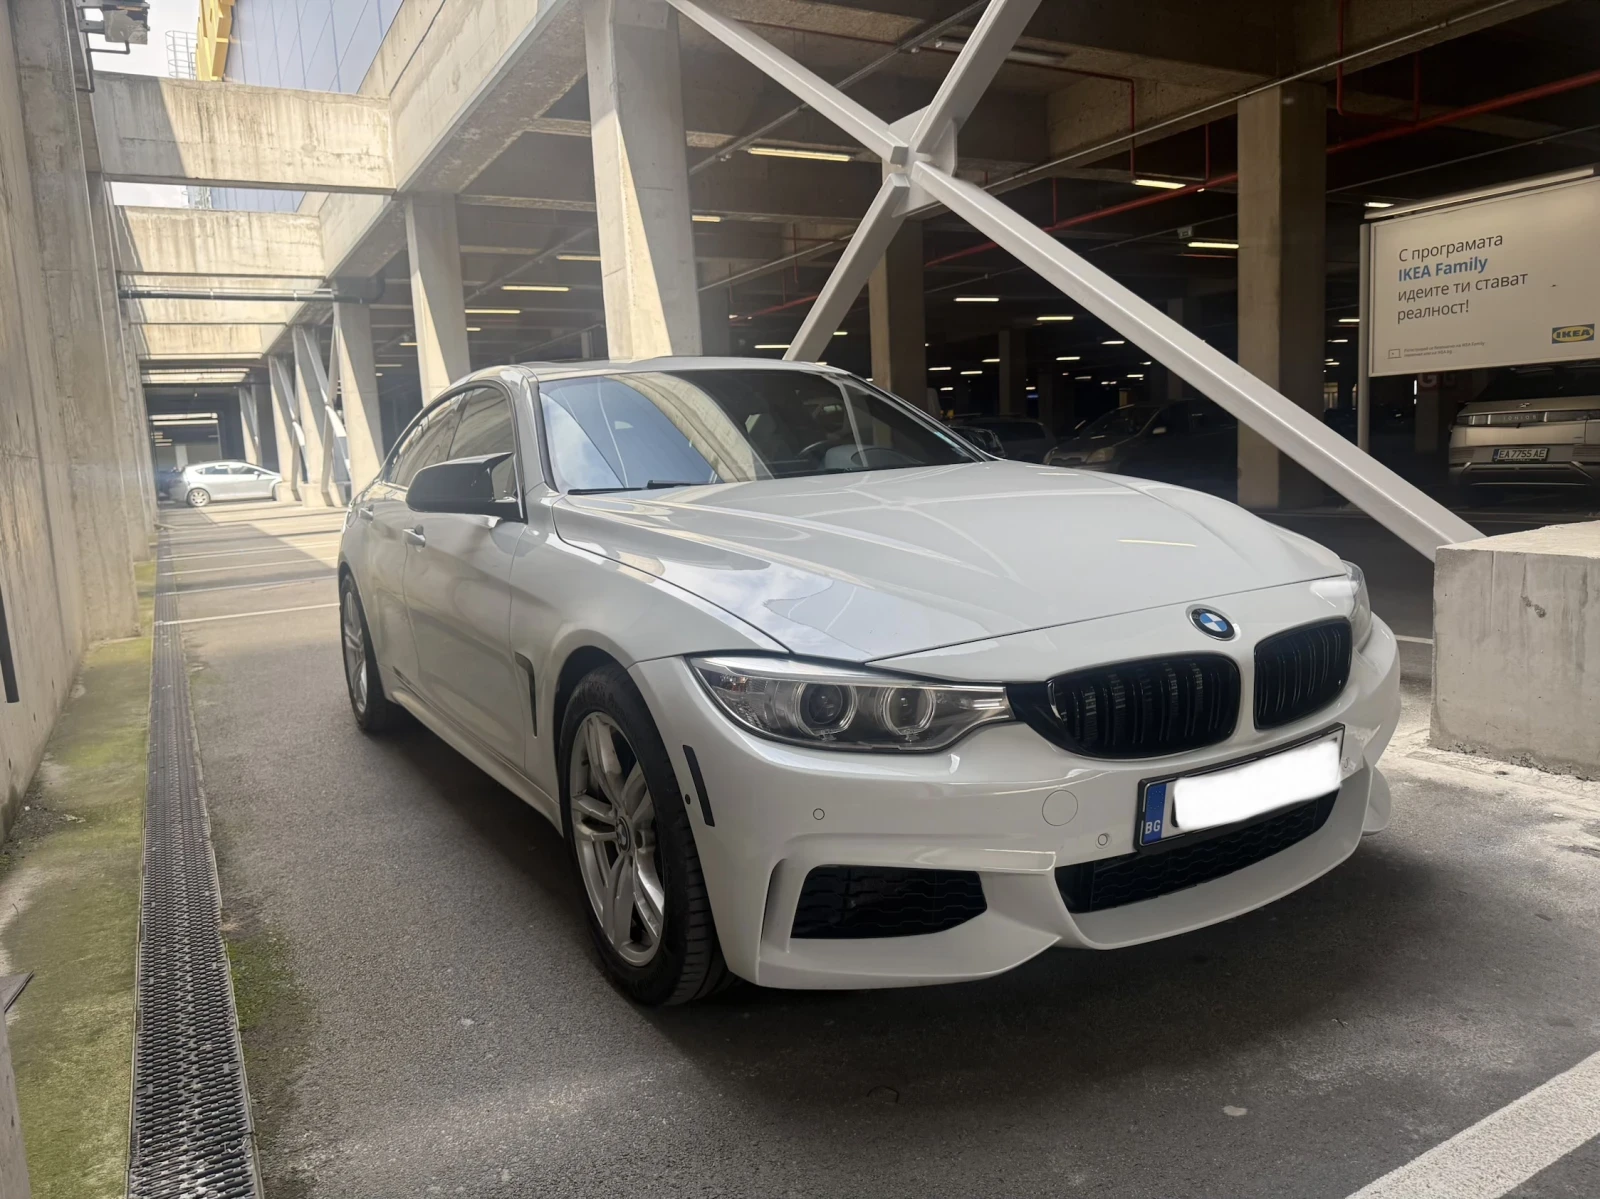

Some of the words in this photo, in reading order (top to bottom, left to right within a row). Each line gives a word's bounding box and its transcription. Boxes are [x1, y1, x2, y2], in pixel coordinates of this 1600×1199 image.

[1398, 248, 1408, 262] С
[1411, 234, 1503, 263] програмата
[1398, 264, 1432, 282] IKEA
[1435, 256, 1488, 276] Family
[1398, 283, 1450, 304] идеите
[1453, 281, 1471, 294] ти
[1475, 273, 1528, 291] стават
[1397, 299, 1469, 325] реалност!
[1556, 328, 1591, 339] IKEA
[1145, 819, 1161, 835] BG
